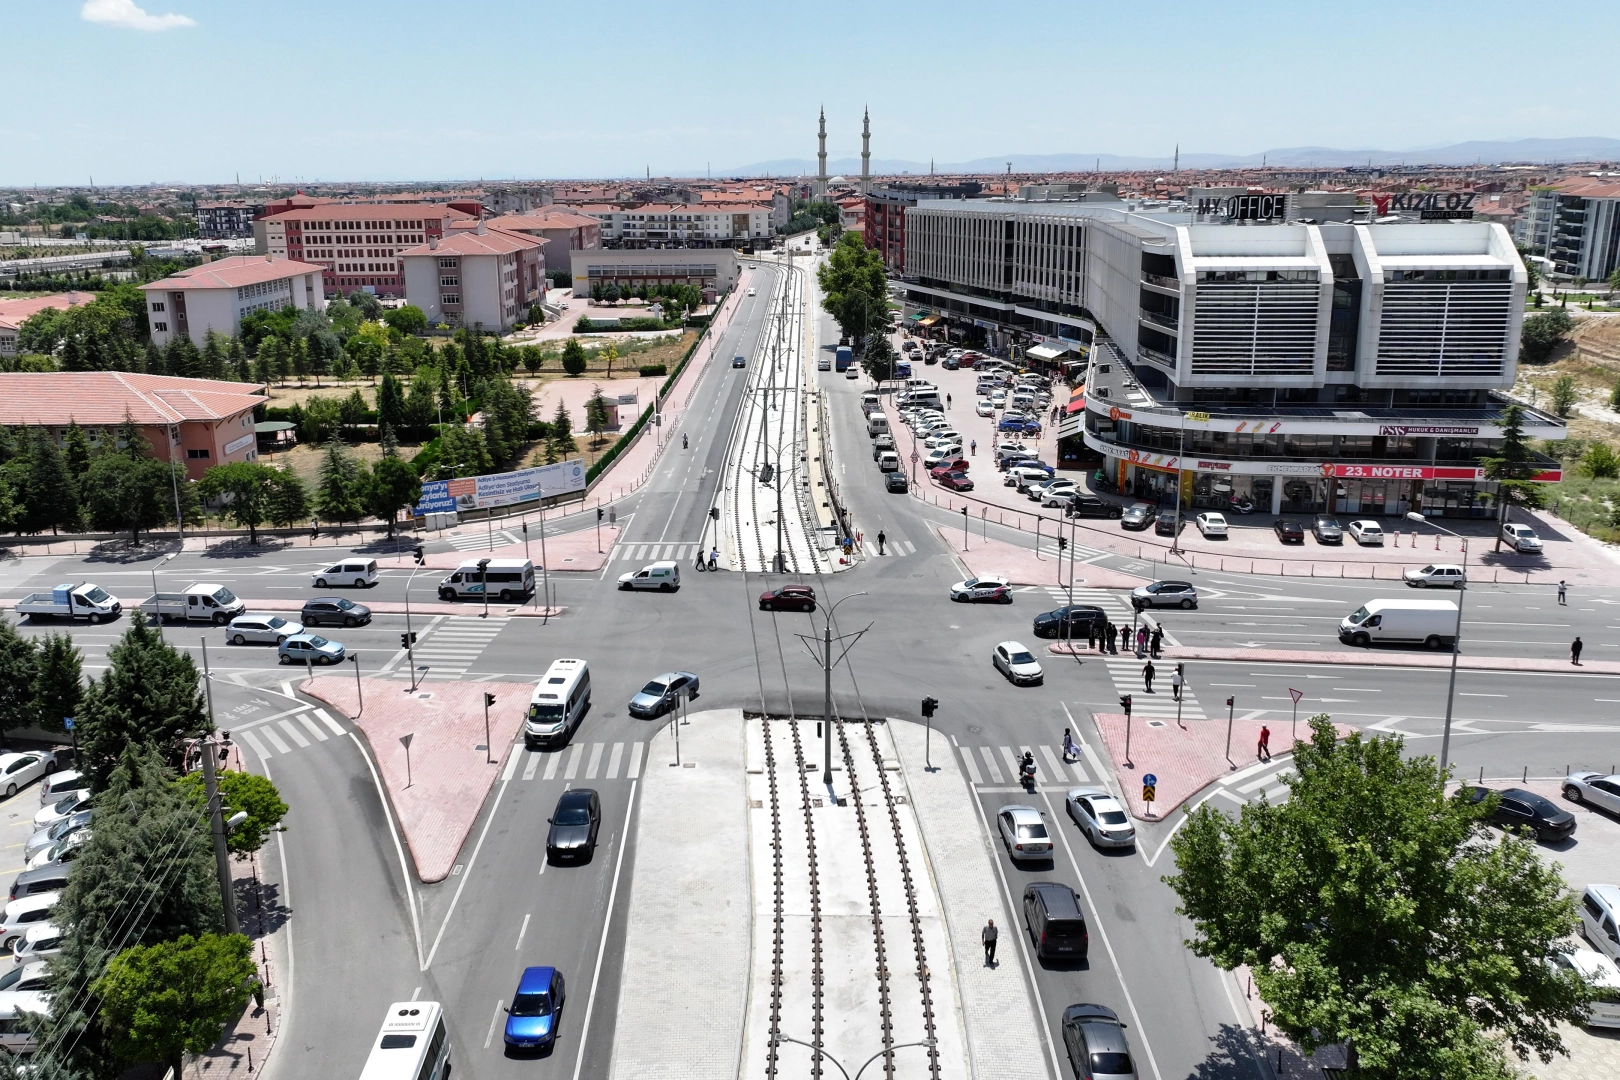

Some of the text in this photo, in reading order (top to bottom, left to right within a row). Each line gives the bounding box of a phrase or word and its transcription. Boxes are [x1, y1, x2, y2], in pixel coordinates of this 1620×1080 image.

[1198, 195, 1284, 218] MY OFFICE
[1345, 466, 1423, 478] 23. NOTER
[419, 483, 447, 492] onya'yı
[418, 491, 447, 501] aylarla
